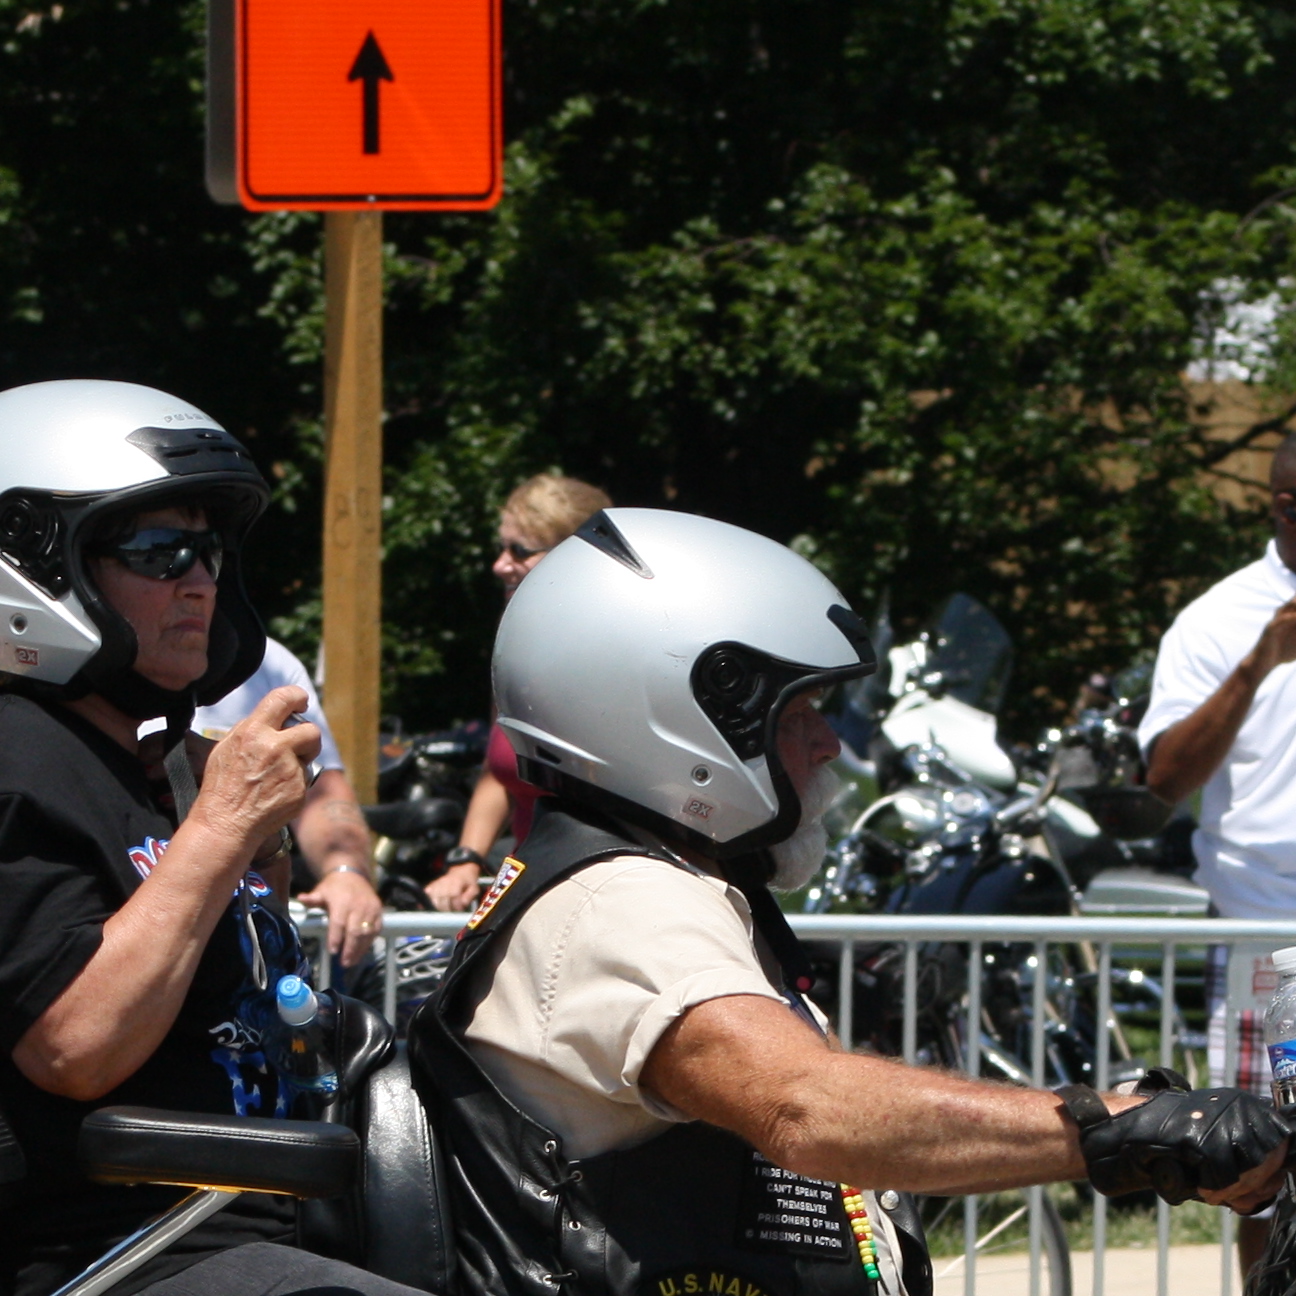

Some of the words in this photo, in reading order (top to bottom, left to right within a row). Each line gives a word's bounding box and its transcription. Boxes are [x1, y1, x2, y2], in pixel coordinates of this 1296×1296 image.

[766, 1183, 793, 1194] CAN'T
[794, 1185, 819, 1199] SPEAK
[820, 1190, 833, 1201] FOR
[776, 1198, 827, 1215] THEMSELVES
[757, 1212, 811, 1227] PRISONERS
[812, 1218, 823, 1228] OF
[824, 1220, 840, 1231] WAR
[759, 1230, 801, 1243] MISSING
[803, 1234, 813, 1244] IN
[814, 1236, 842, 1248] ACTION
